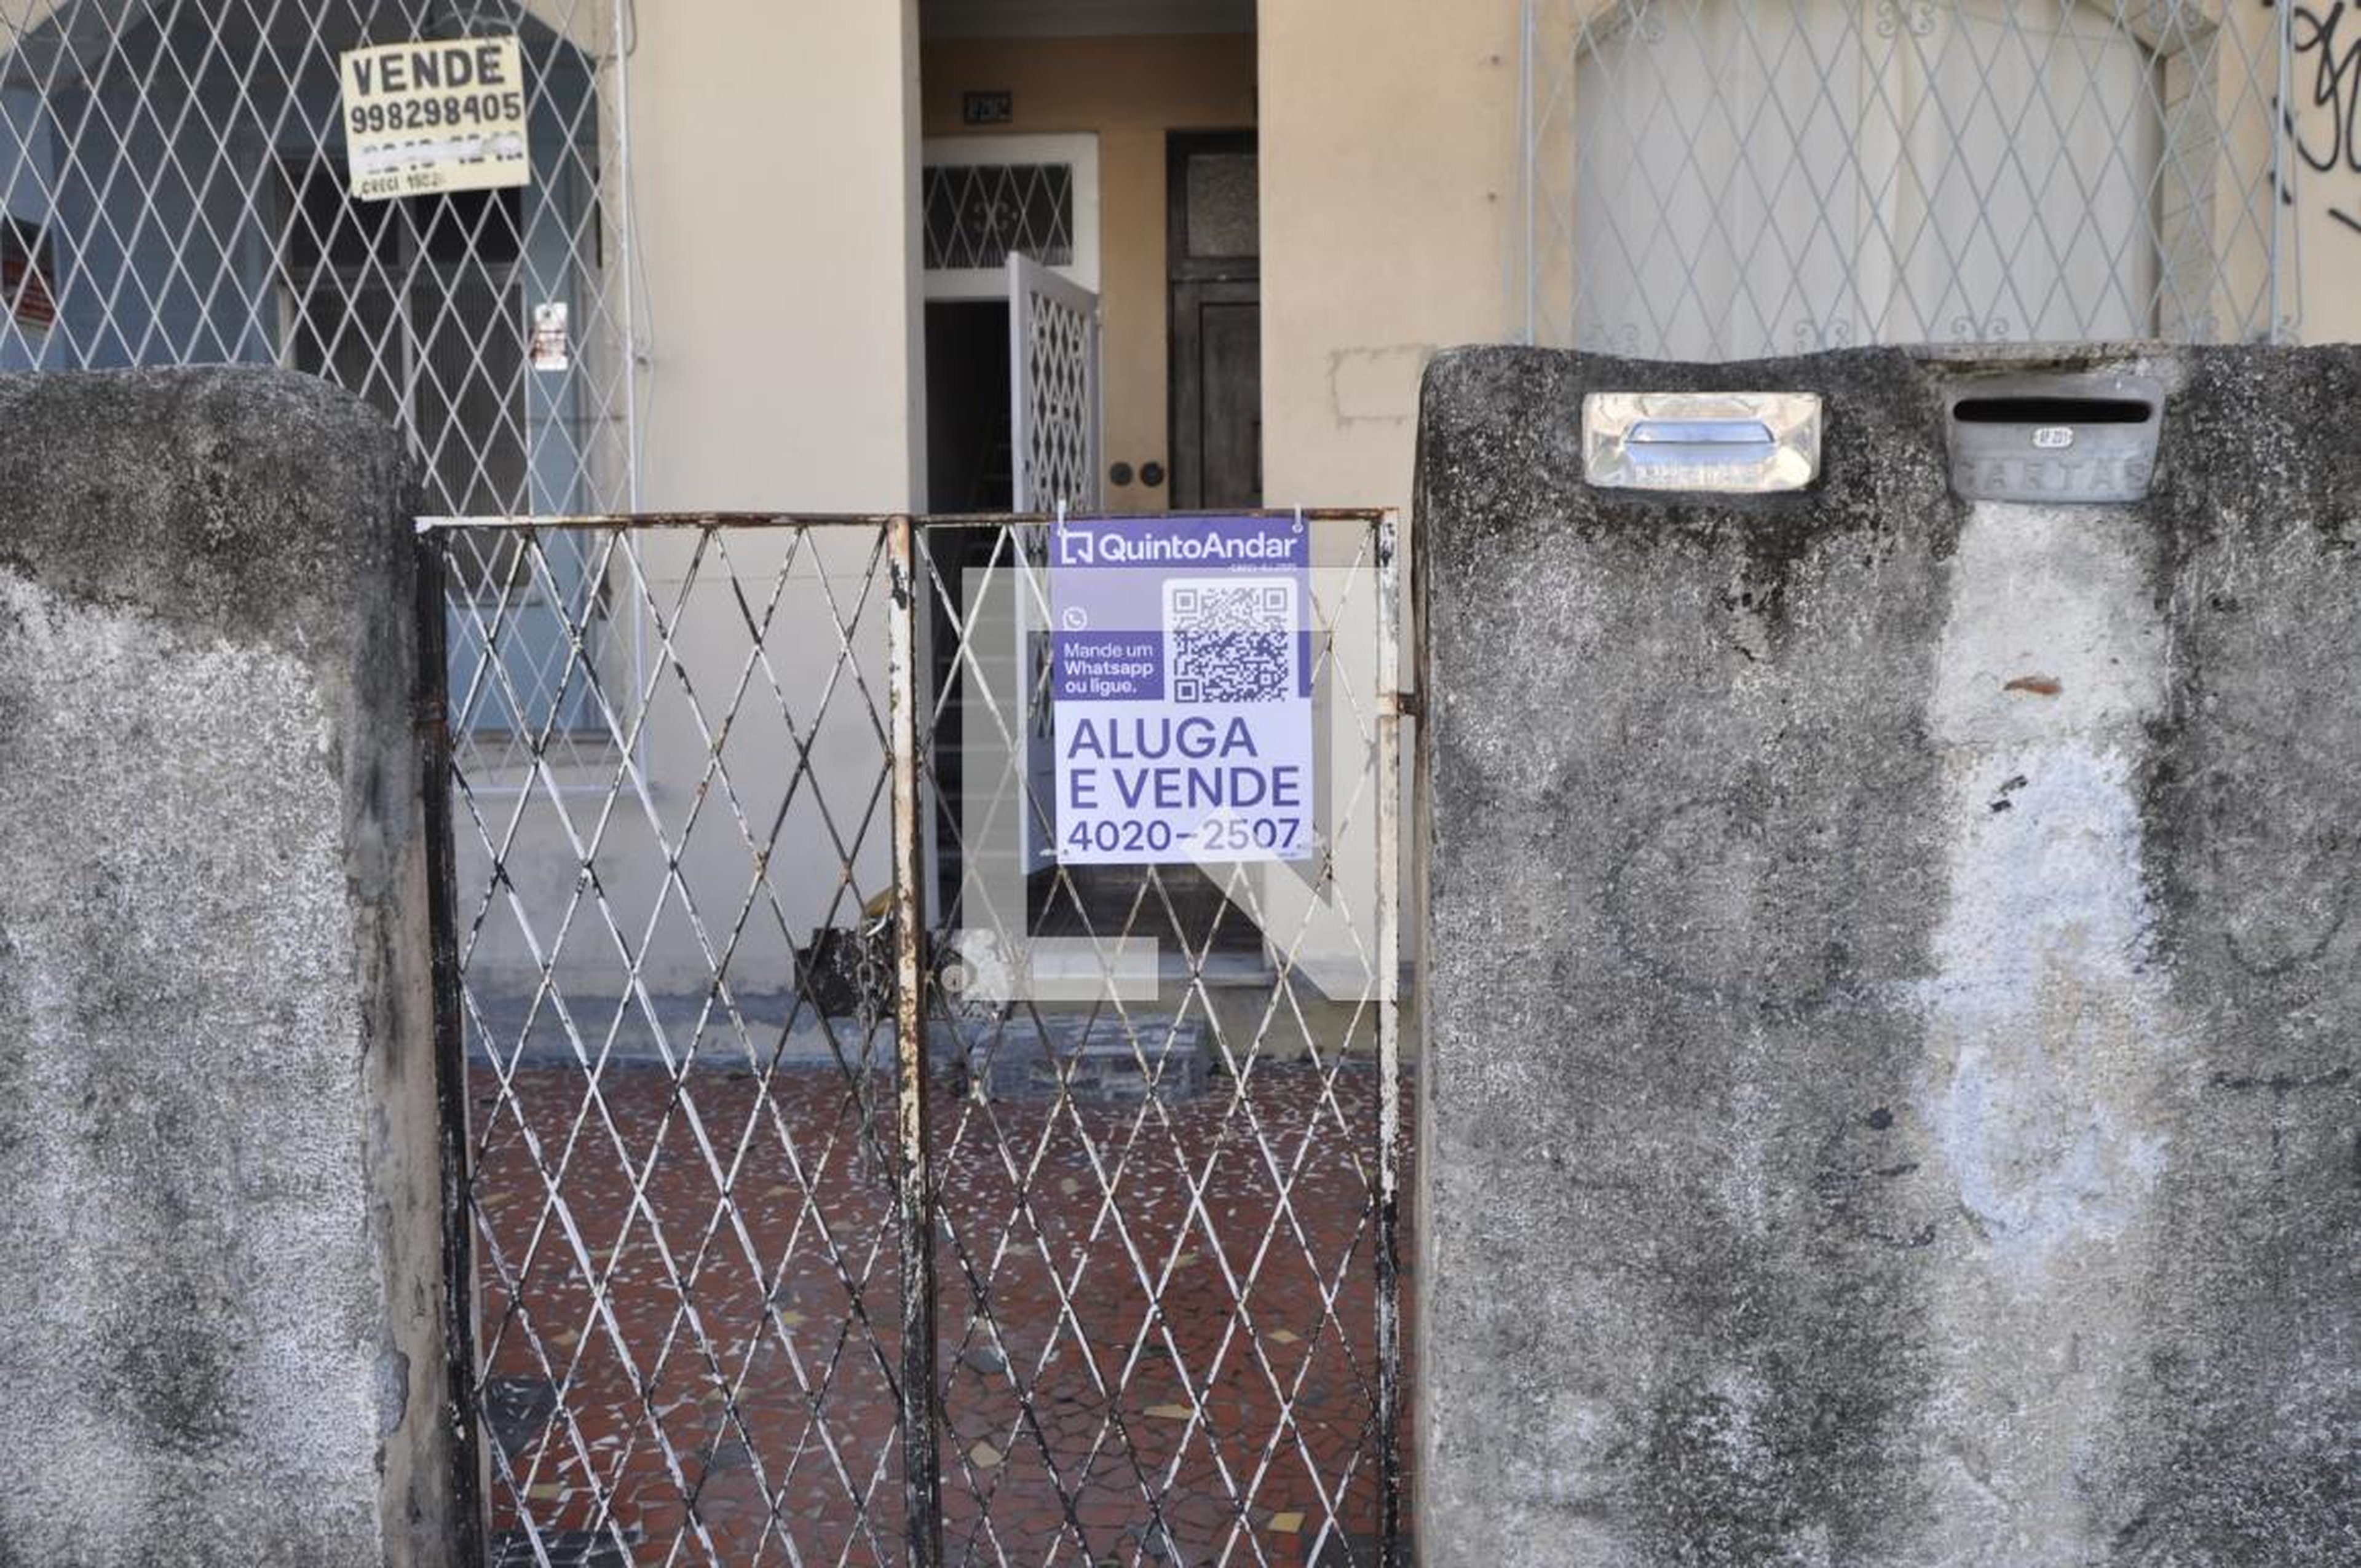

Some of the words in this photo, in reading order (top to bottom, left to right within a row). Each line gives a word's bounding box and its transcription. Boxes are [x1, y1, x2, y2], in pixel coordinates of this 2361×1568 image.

[353, 46, 505, 97] VENDE
[351, 92, 521, 133] 998298405
[1098, 532, 1297, 561] QuintoAndar
[1063, 643, 1121, 658] Mande
[1126, 646, 1153, 658] um
[1065, 662, 1153, 679] Whatsapp
[1066, 681, 1089, 693] ou
[1090, 677, 1137, 697] ligue.
[1067, 717, 1258, 759] ALUGA
[1070, 769, 1097, 809] E
[1113, 766, 1300, 808] VENDE
[1068, 819, 1300, 851] 4020-2507
